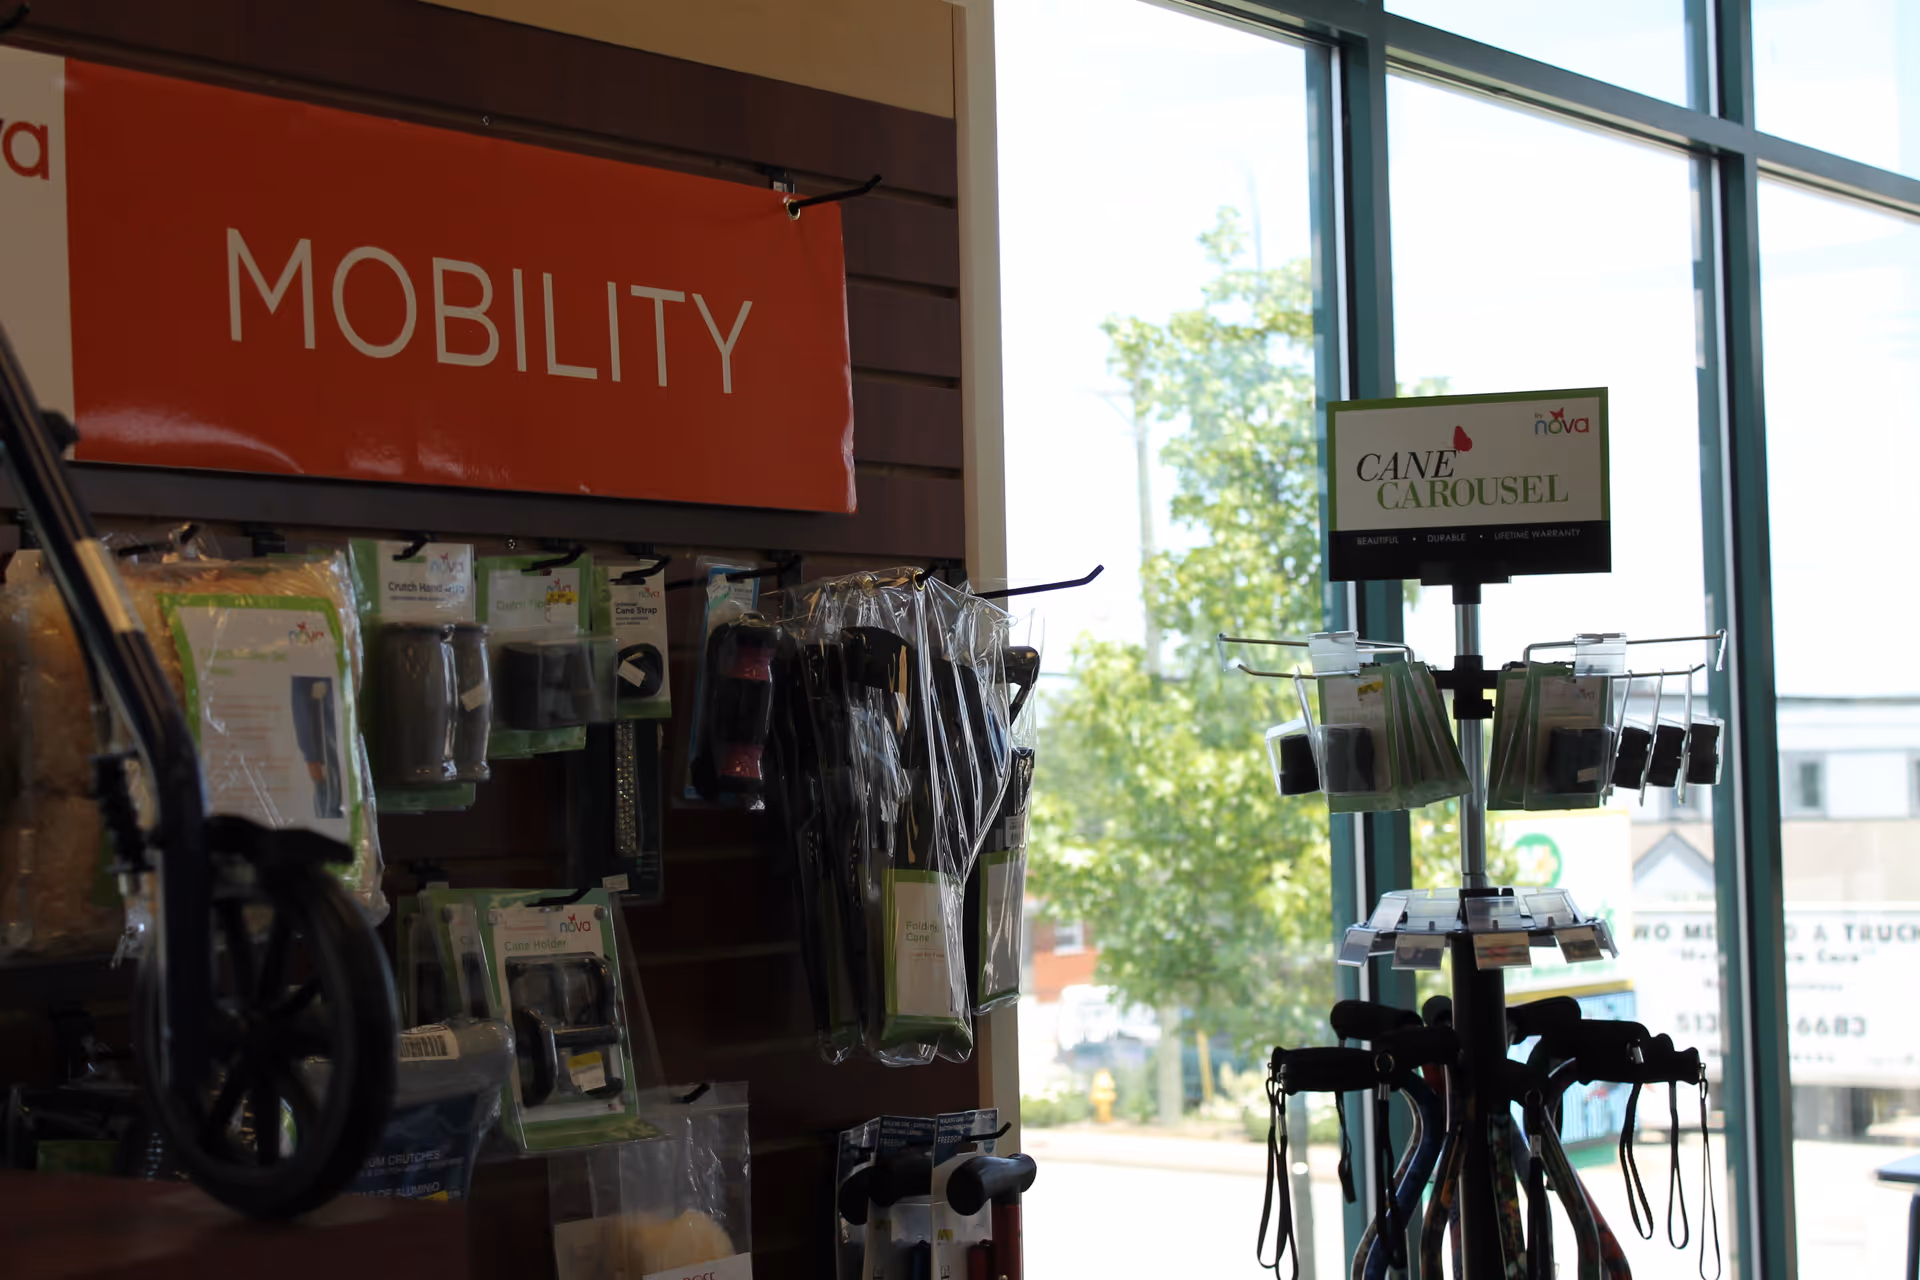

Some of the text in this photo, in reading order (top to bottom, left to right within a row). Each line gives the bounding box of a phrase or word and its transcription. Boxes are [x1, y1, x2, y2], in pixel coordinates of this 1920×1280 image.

[226, 227, 753, 394] MOBILITY
[1534, 418, 1590, 435] nova
[1356, 449, 1459, 482] CANE
[1376, 474, 1569, 510] CAROUSEL
[1356, 528, 1581, 545] BEAUTIFUL DURABLE LIFETIME WARRANTY
[636, 606, 658, 616] Strap
[559, 920, 592, 934] nova
[532, 938, 567, 950] Holder
[387, 1149, 441, 1166] CRUTCHES
